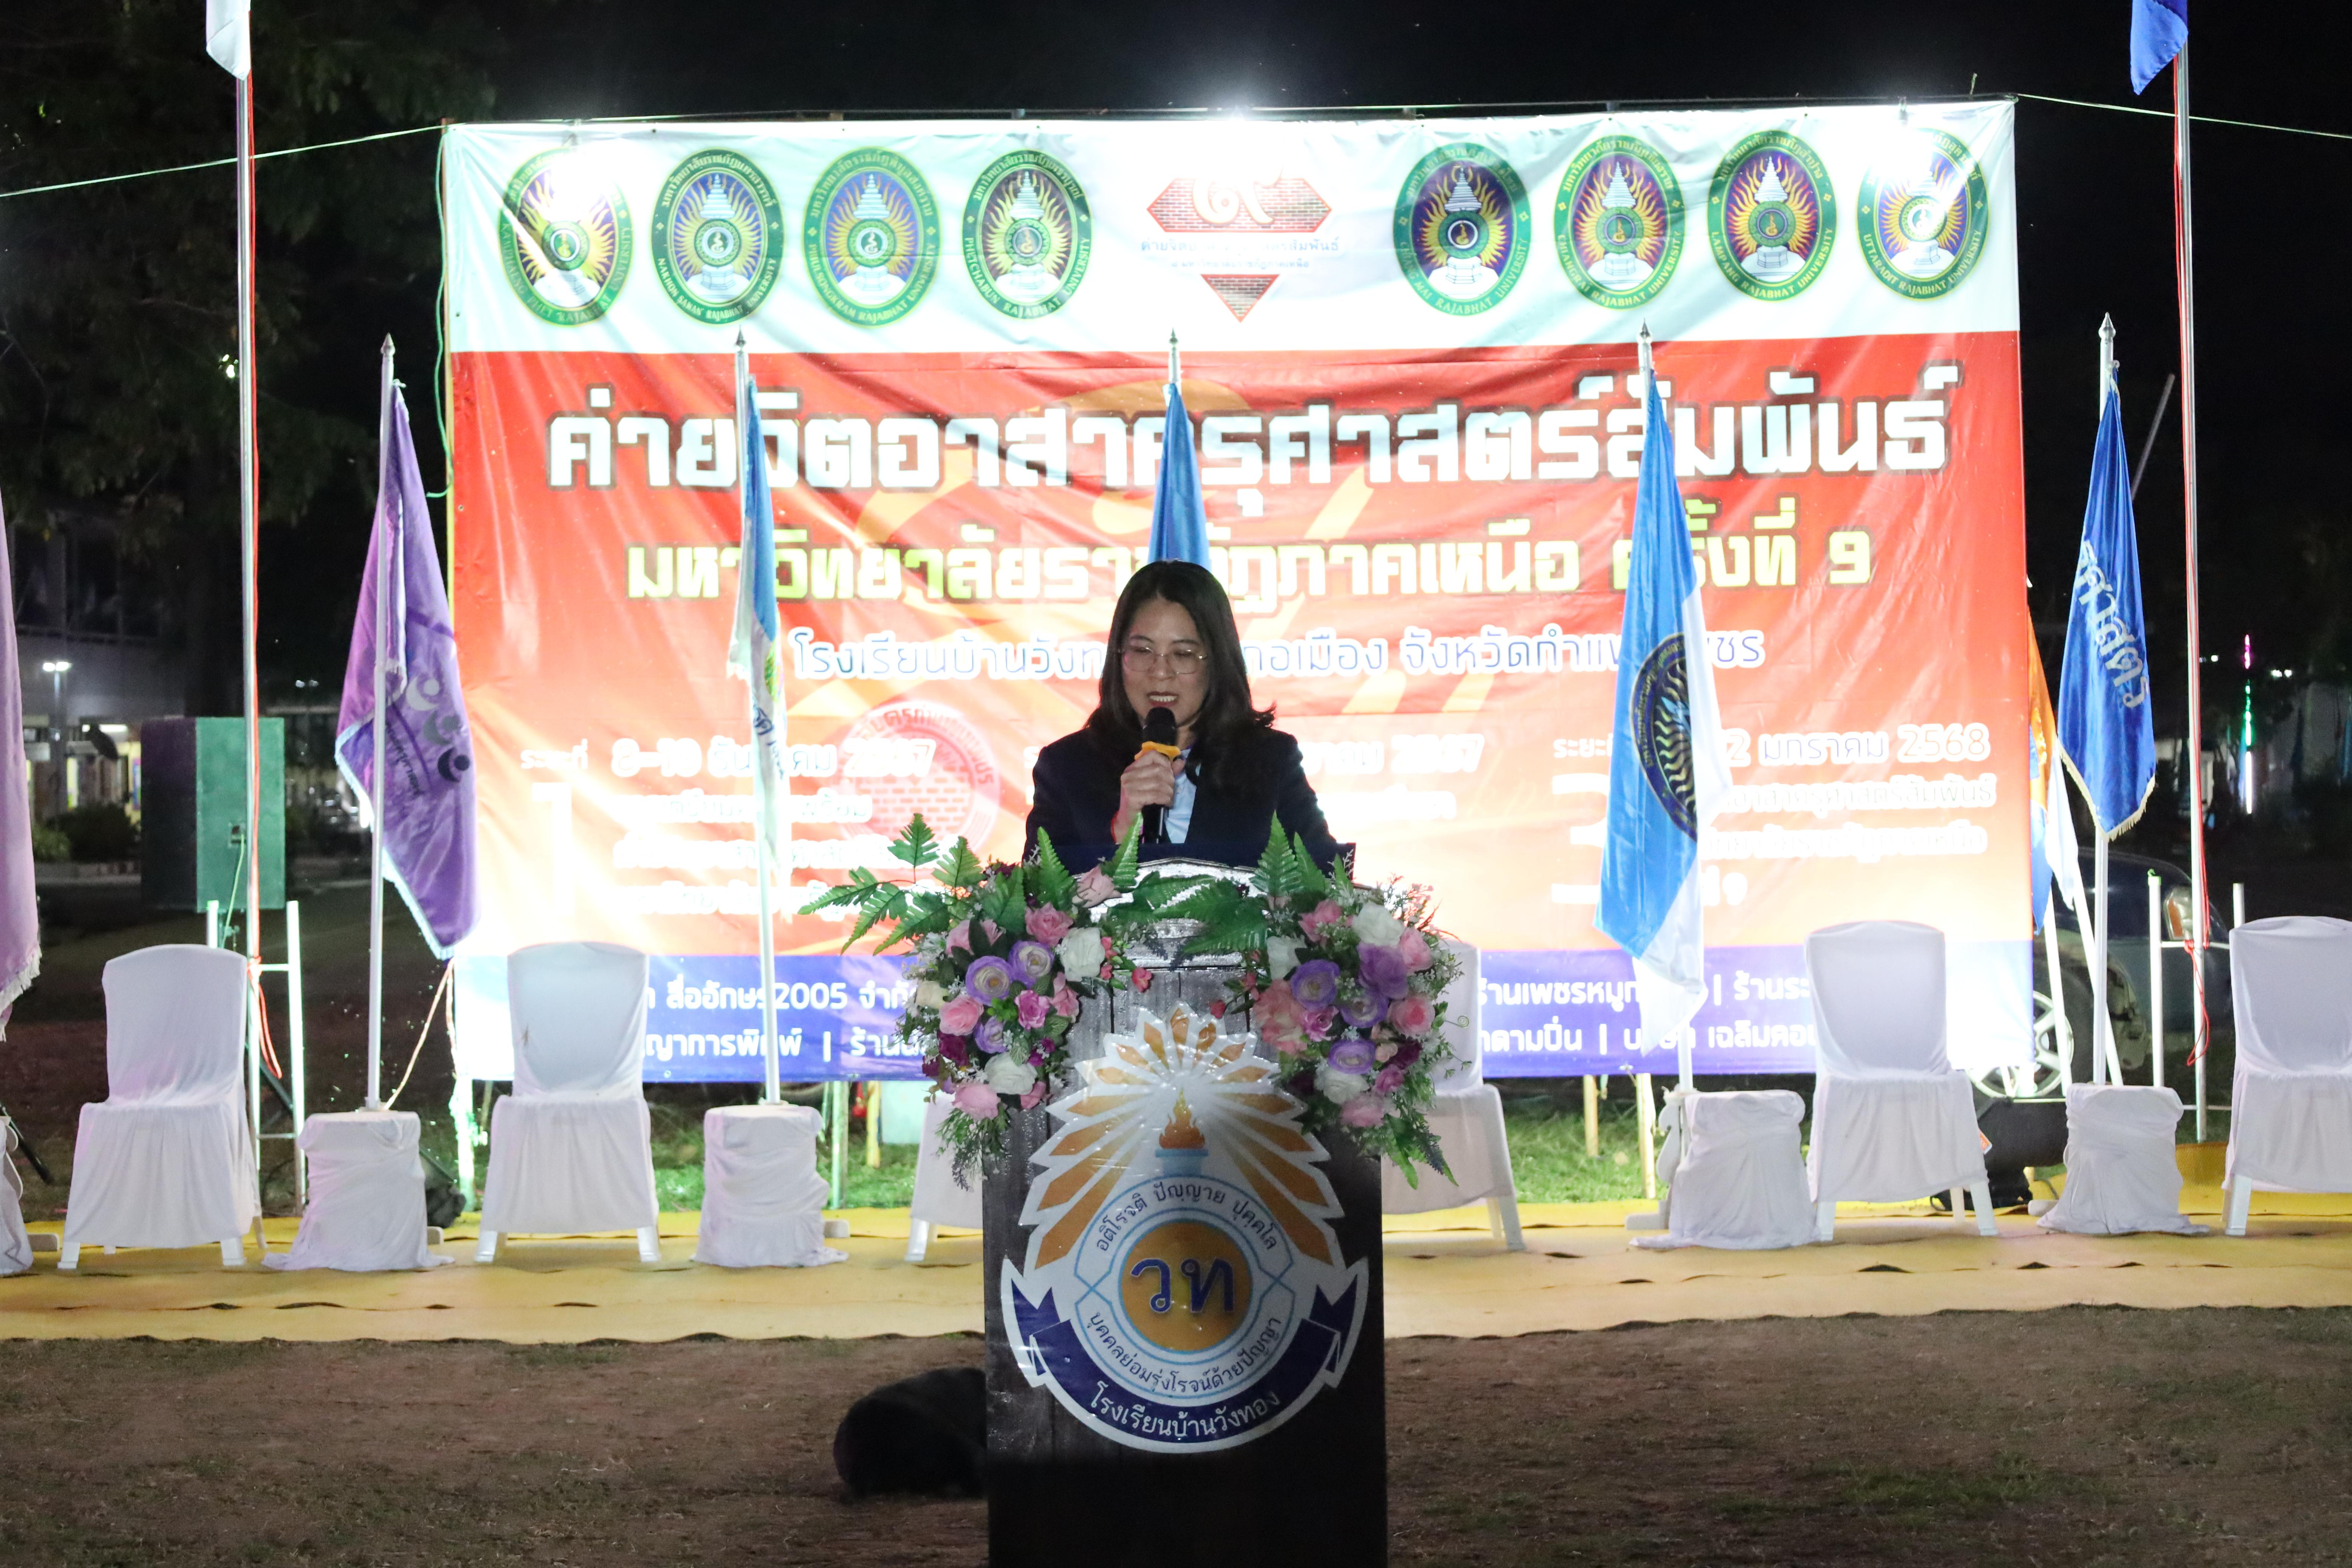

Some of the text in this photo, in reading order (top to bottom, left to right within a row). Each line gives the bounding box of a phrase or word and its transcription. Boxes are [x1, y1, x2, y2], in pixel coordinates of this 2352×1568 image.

[658, 257, 777, 321] NAKHON SAWAN RAJABHAT UNIVERSITY
[858, 301, 909, 323] RAJABHAT
[906, 243, 936, 301] UNIVERSITY
[965, 237, 1090, 317] PHETCHABUN RAJABHAT UNIVERSITY
[1415, 281, 1433, 300] MAI
[1436, 297, 1493, 315] RAJABHAT
[1495, 237, 1528, 299] UNIVERSITY
[1591, 290, 1647, 307] RAJABHAT
[1648, 231, 1682, 296] UNIVERSITY
[1712, 228, 1833, 299] LAMPANG RAJABHAT UNIVERSITY
[1863, 229, 1982, 296] UTTARADIT RAJABHAT UNIVERSITY
[627, 518, 1579, 613] มหวิทยาลัยราัฏภาคเหนือ
[791, 629, 1104, 676] โรงเรียนบ้านวังท
[1760, 732, 1888, 765] มกราคม
[1898, 724, 1989, 760] 2568
[859, 980, 916, 1009] จำกั
[1087, 1312, 1282, 1394] บุคคลย่อมรุ่งโรจน์ด้วยปัญญา
[1091, 1380, 1281, 1437] โรงเรียนบ้านวังทอง
